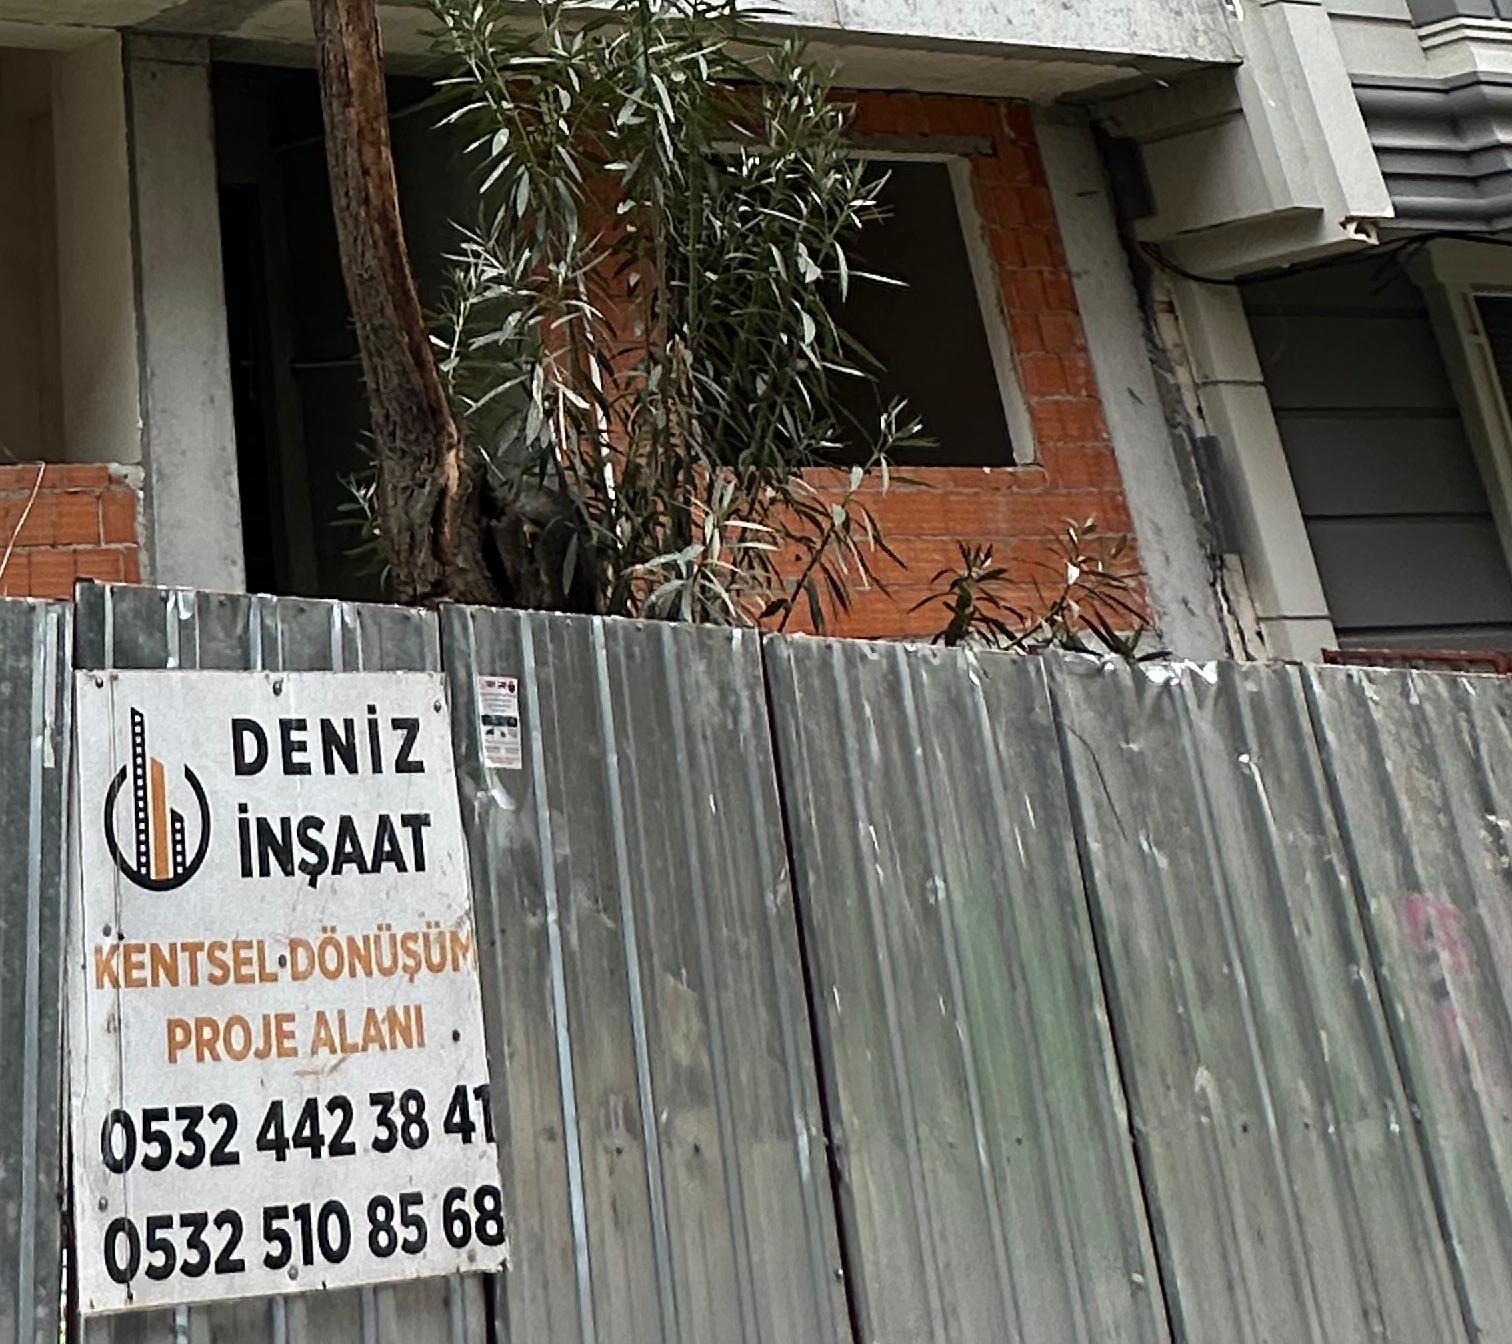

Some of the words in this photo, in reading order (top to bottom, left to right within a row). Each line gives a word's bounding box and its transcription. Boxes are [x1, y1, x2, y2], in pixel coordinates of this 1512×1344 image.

[231, 704, 425, 776] DENİZ
[238, 803, 431, 889] İNŞAAT
[94, 938, 278, 990] KENTSEL
[288, 921, 473, 983] DÖNÜŞÜM
[166, 1012, 298, 1064] PROJE
[310, 1004, 426, 1057] ALANI
[101, 1103, 240, 1174] 0532
[256, 1095, 356, 1161] 442
[369, 1088, 430, 1153] 38
[443, 1084, 496, 1144] 41
[104, 1209, 245, 1284] 0532
[262, 1199, 351, 1270] 510
[367, 1191, 427, 1258] 85
[443, 1184, 506, 1249] 68
